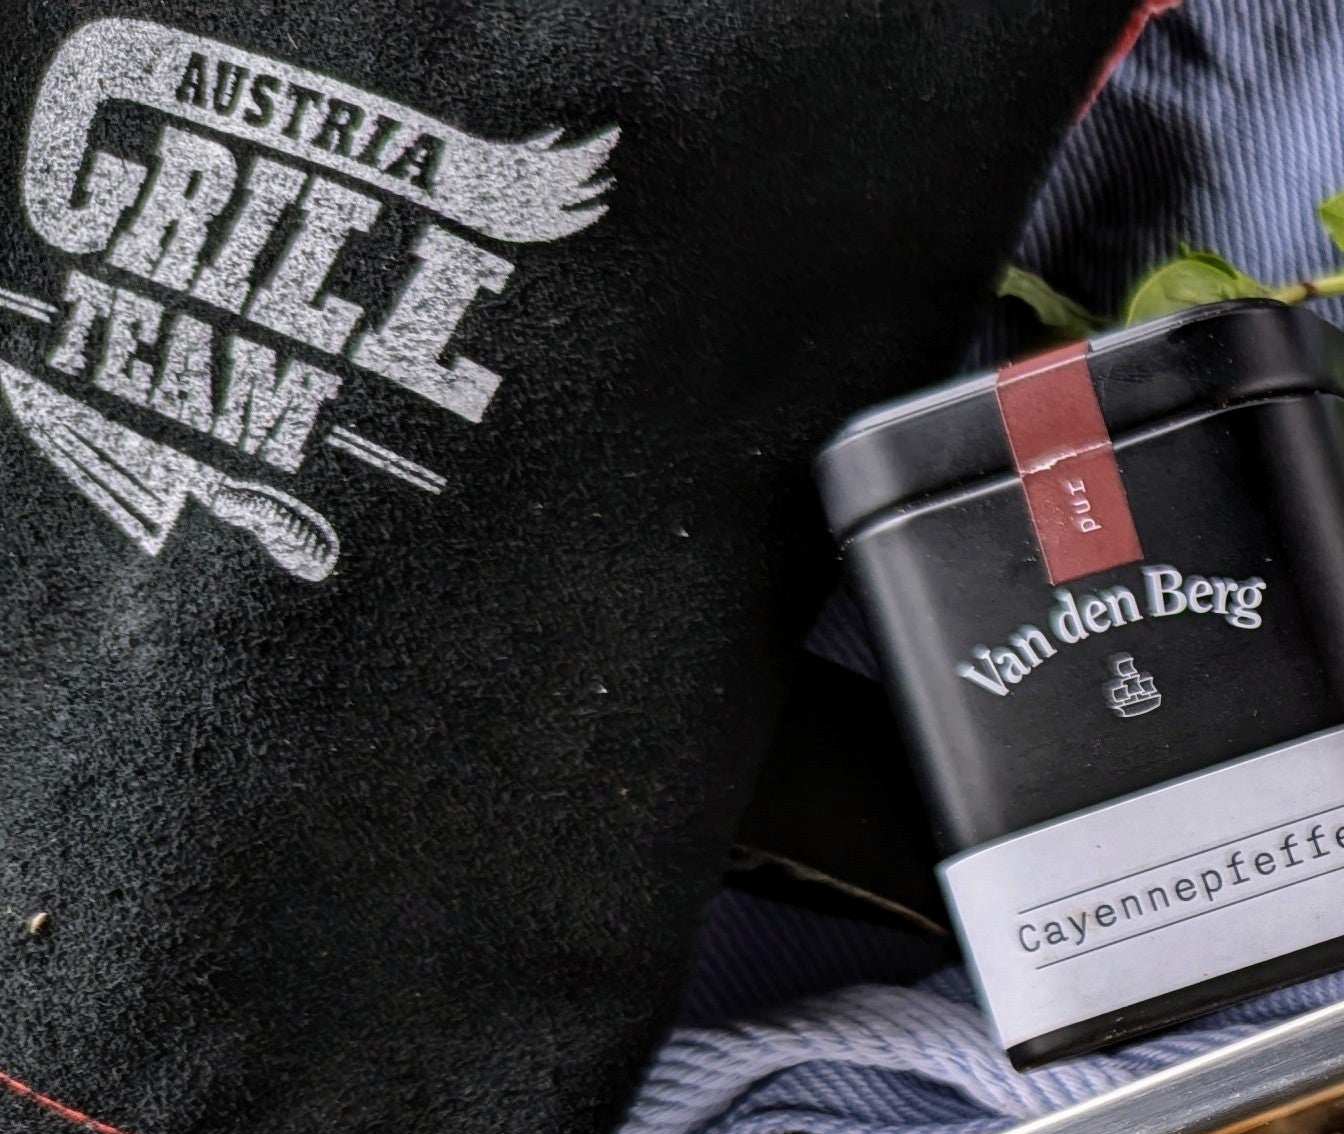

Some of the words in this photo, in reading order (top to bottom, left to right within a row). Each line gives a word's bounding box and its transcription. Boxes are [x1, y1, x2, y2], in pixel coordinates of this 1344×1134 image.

[175, 50, 447, 195] AUSTRIA
[22, 85, 516, 424] GRILL
[46, 270, 343, 474] TEAM
[956, 624, 1058, 697] Van
[1052, 586, 1144, 645] den
[1141, 564, 1267, 630] Berg
